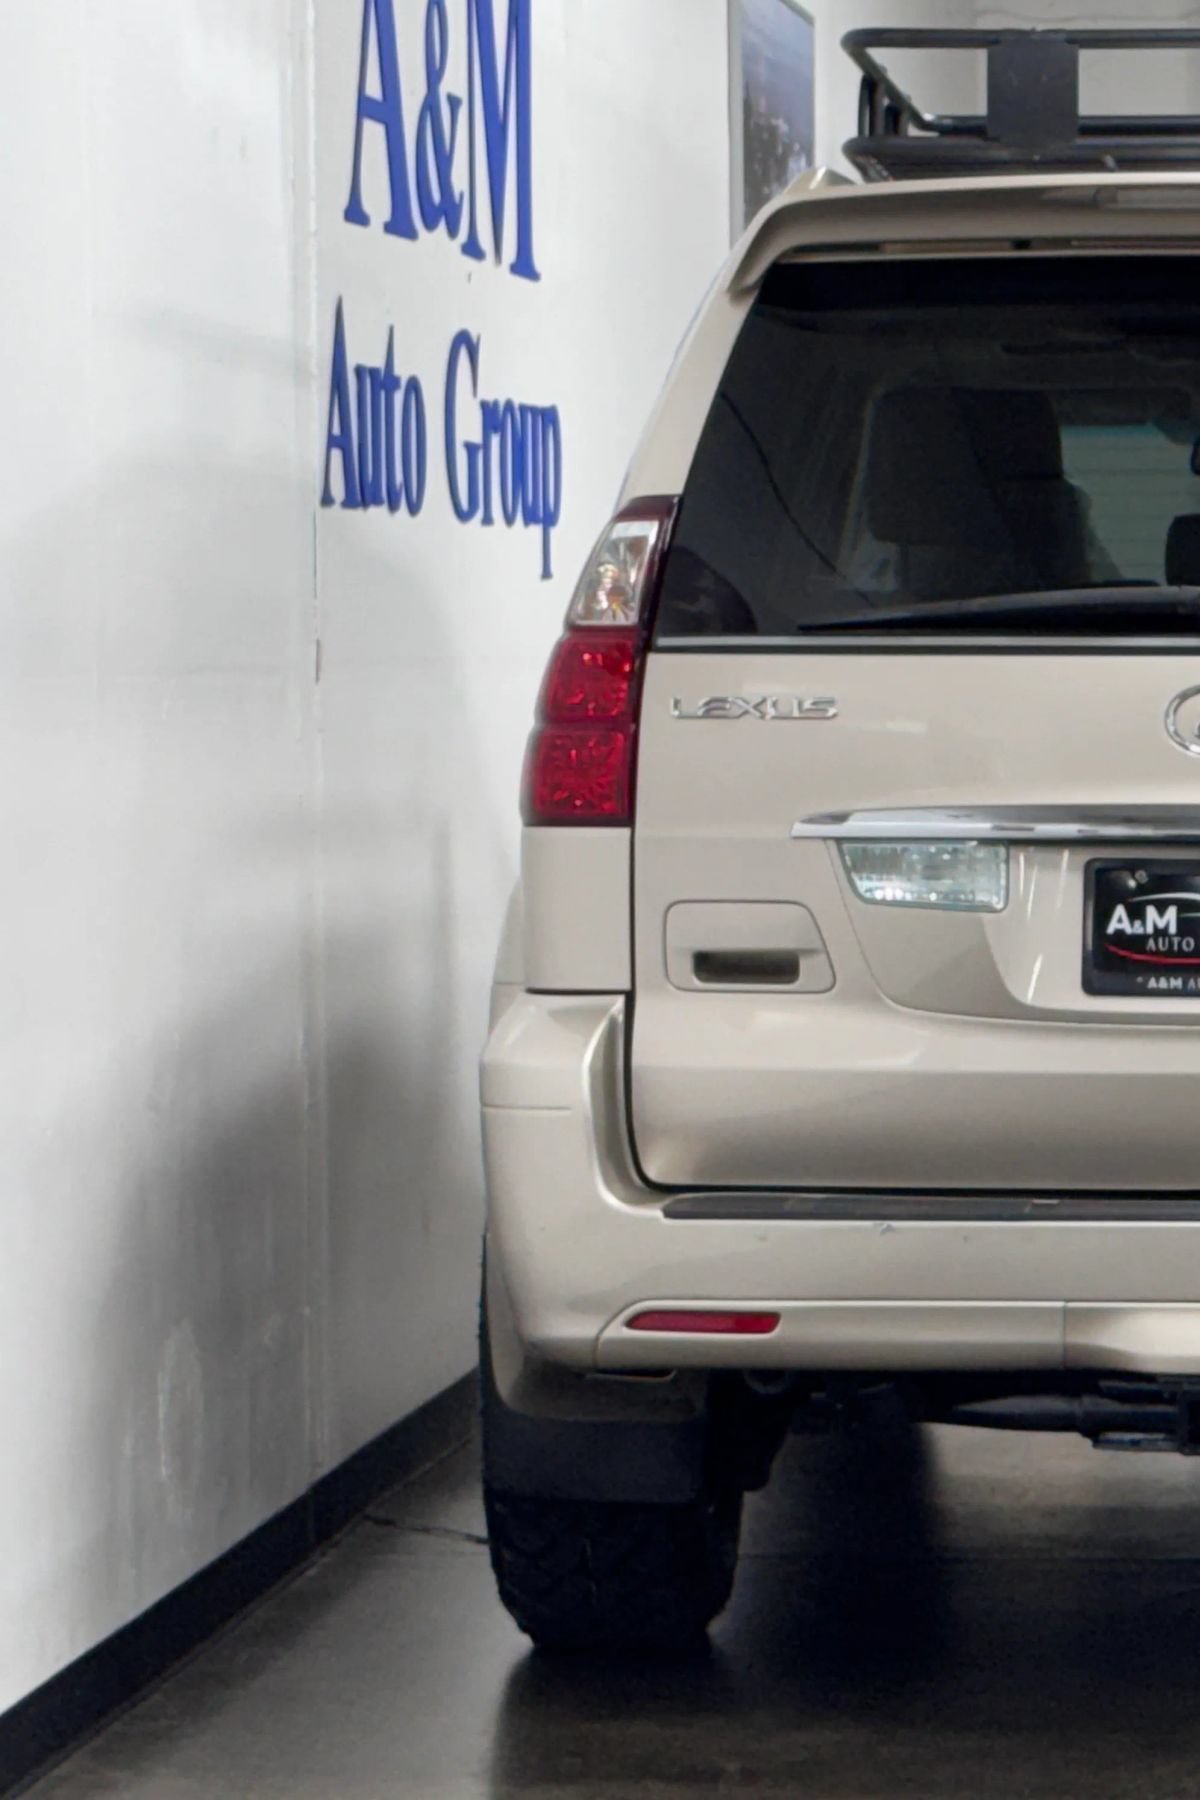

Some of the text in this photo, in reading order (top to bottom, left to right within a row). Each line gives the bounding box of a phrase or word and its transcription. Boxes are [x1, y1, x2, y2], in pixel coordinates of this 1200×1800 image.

[343, 0, 541, 281] A&M
[320, 295, 562, 580] Auto Group
[670, 696, 838, 720] LEXUS
[1106, 903, 1178, 935] A&M
[1146, 936, 1195, 952] AUTO
[1147, 977, 1183, 990] A&M
